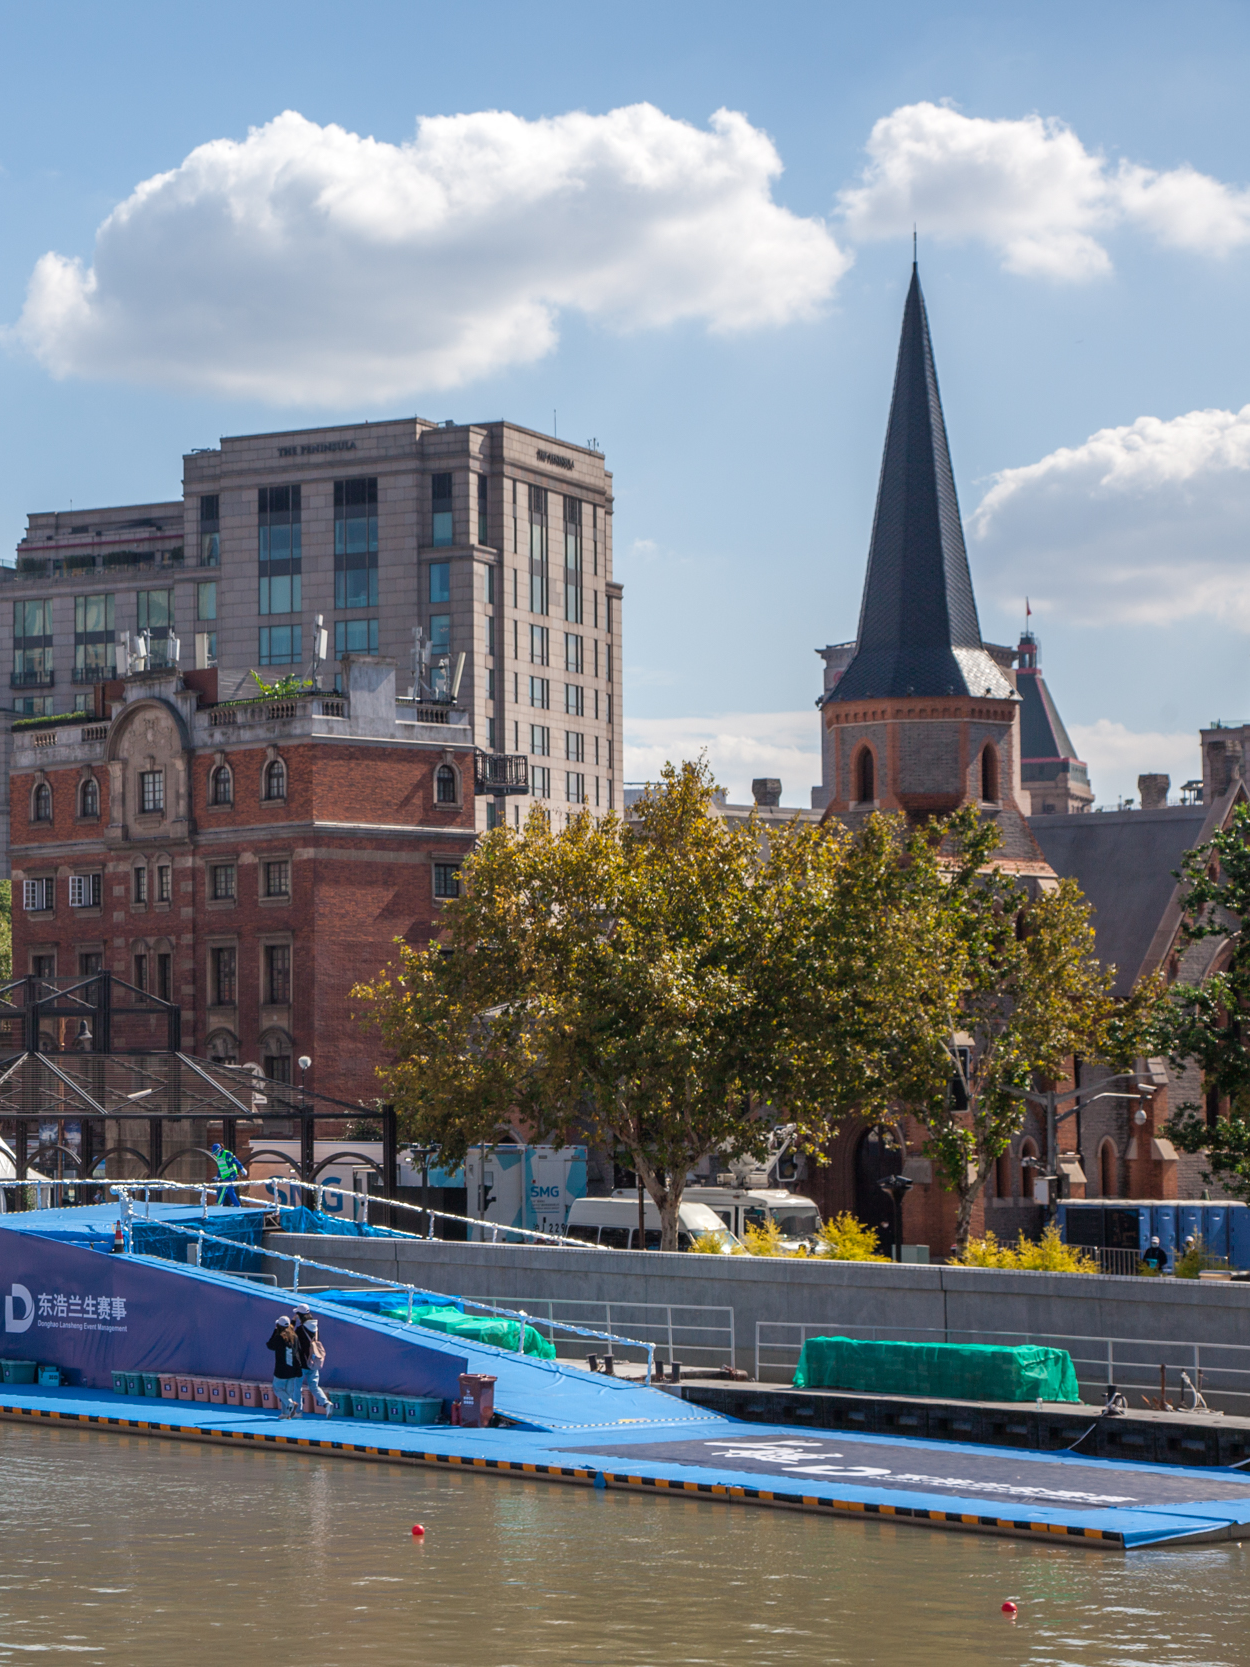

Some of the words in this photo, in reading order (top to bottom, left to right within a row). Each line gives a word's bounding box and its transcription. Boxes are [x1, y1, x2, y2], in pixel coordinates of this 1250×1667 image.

[531, 1186, 559, 1198] SMG
[37, 1292, 127, 1321] 东浩兰生赛事
[37, 1319, 59, 1329] Donghao
[59, 1321, 83, 1331] Lansheng
[83, 1322, 97, 1331] Event
[97, 1323, 128, 1333] Management
